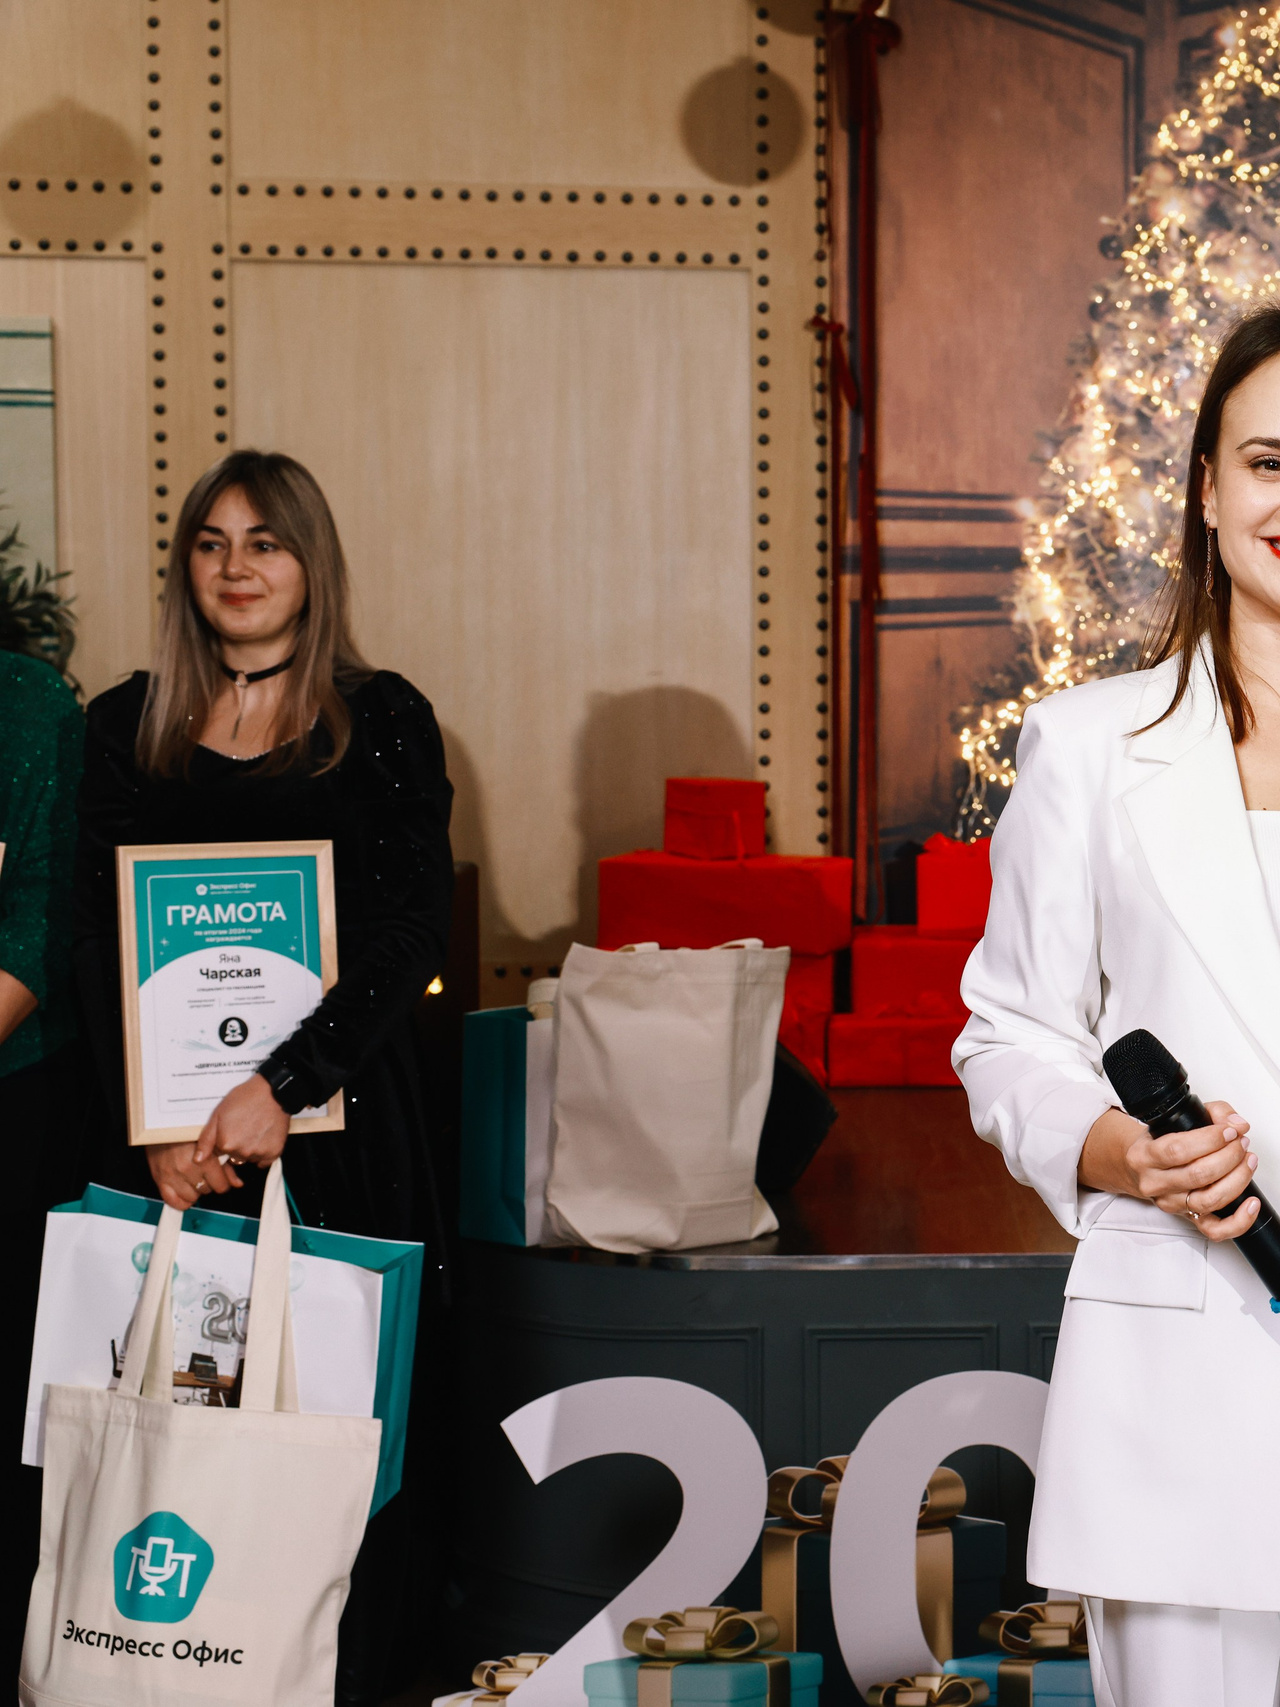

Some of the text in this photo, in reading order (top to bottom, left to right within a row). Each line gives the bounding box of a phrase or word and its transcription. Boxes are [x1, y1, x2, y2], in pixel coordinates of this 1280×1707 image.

[166, 901, 287, 926] ГРАМОТА
[218, 953, 241, 964] Яна
[199, 967, 261, 982] Чарская
[62, 1619, 244, 1668] Экспресс Офис
